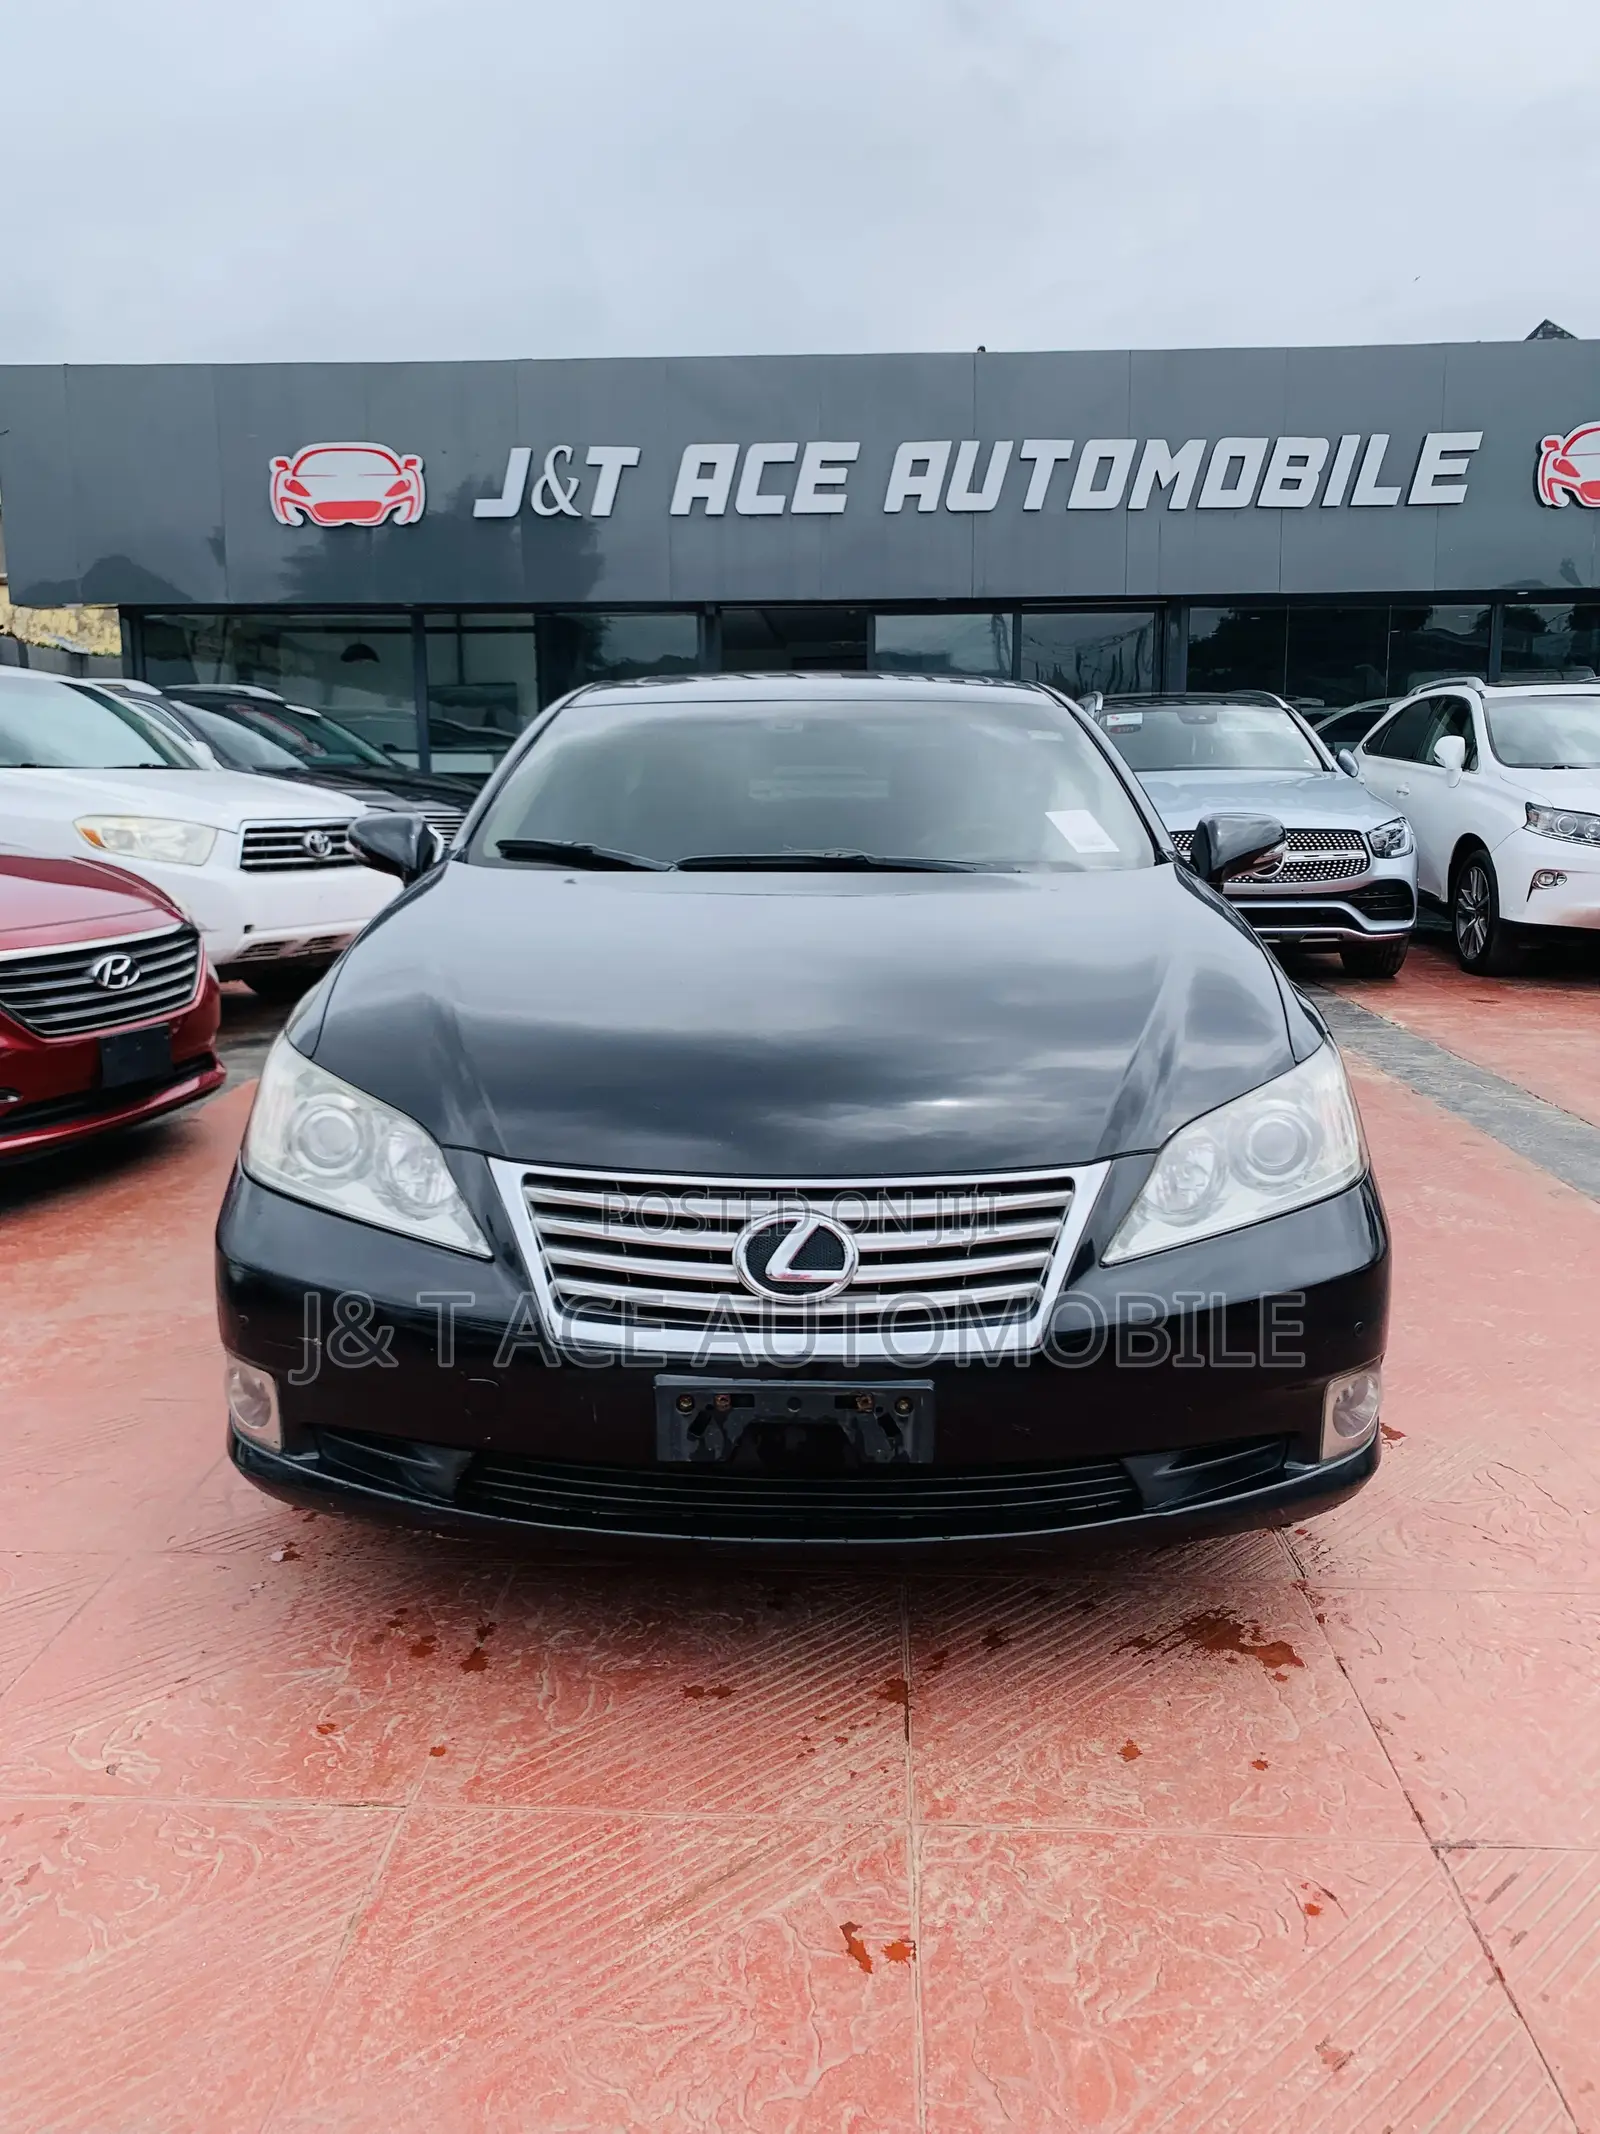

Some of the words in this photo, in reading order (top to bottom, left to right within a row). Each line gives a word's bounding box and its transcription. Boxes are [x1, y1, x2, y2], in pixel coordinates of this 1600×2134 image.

[472, 444, 641, 518] J&T
[670, 441, 859, 515] ACE
[883, 431, 1483, 513] AUTOMOBILE
